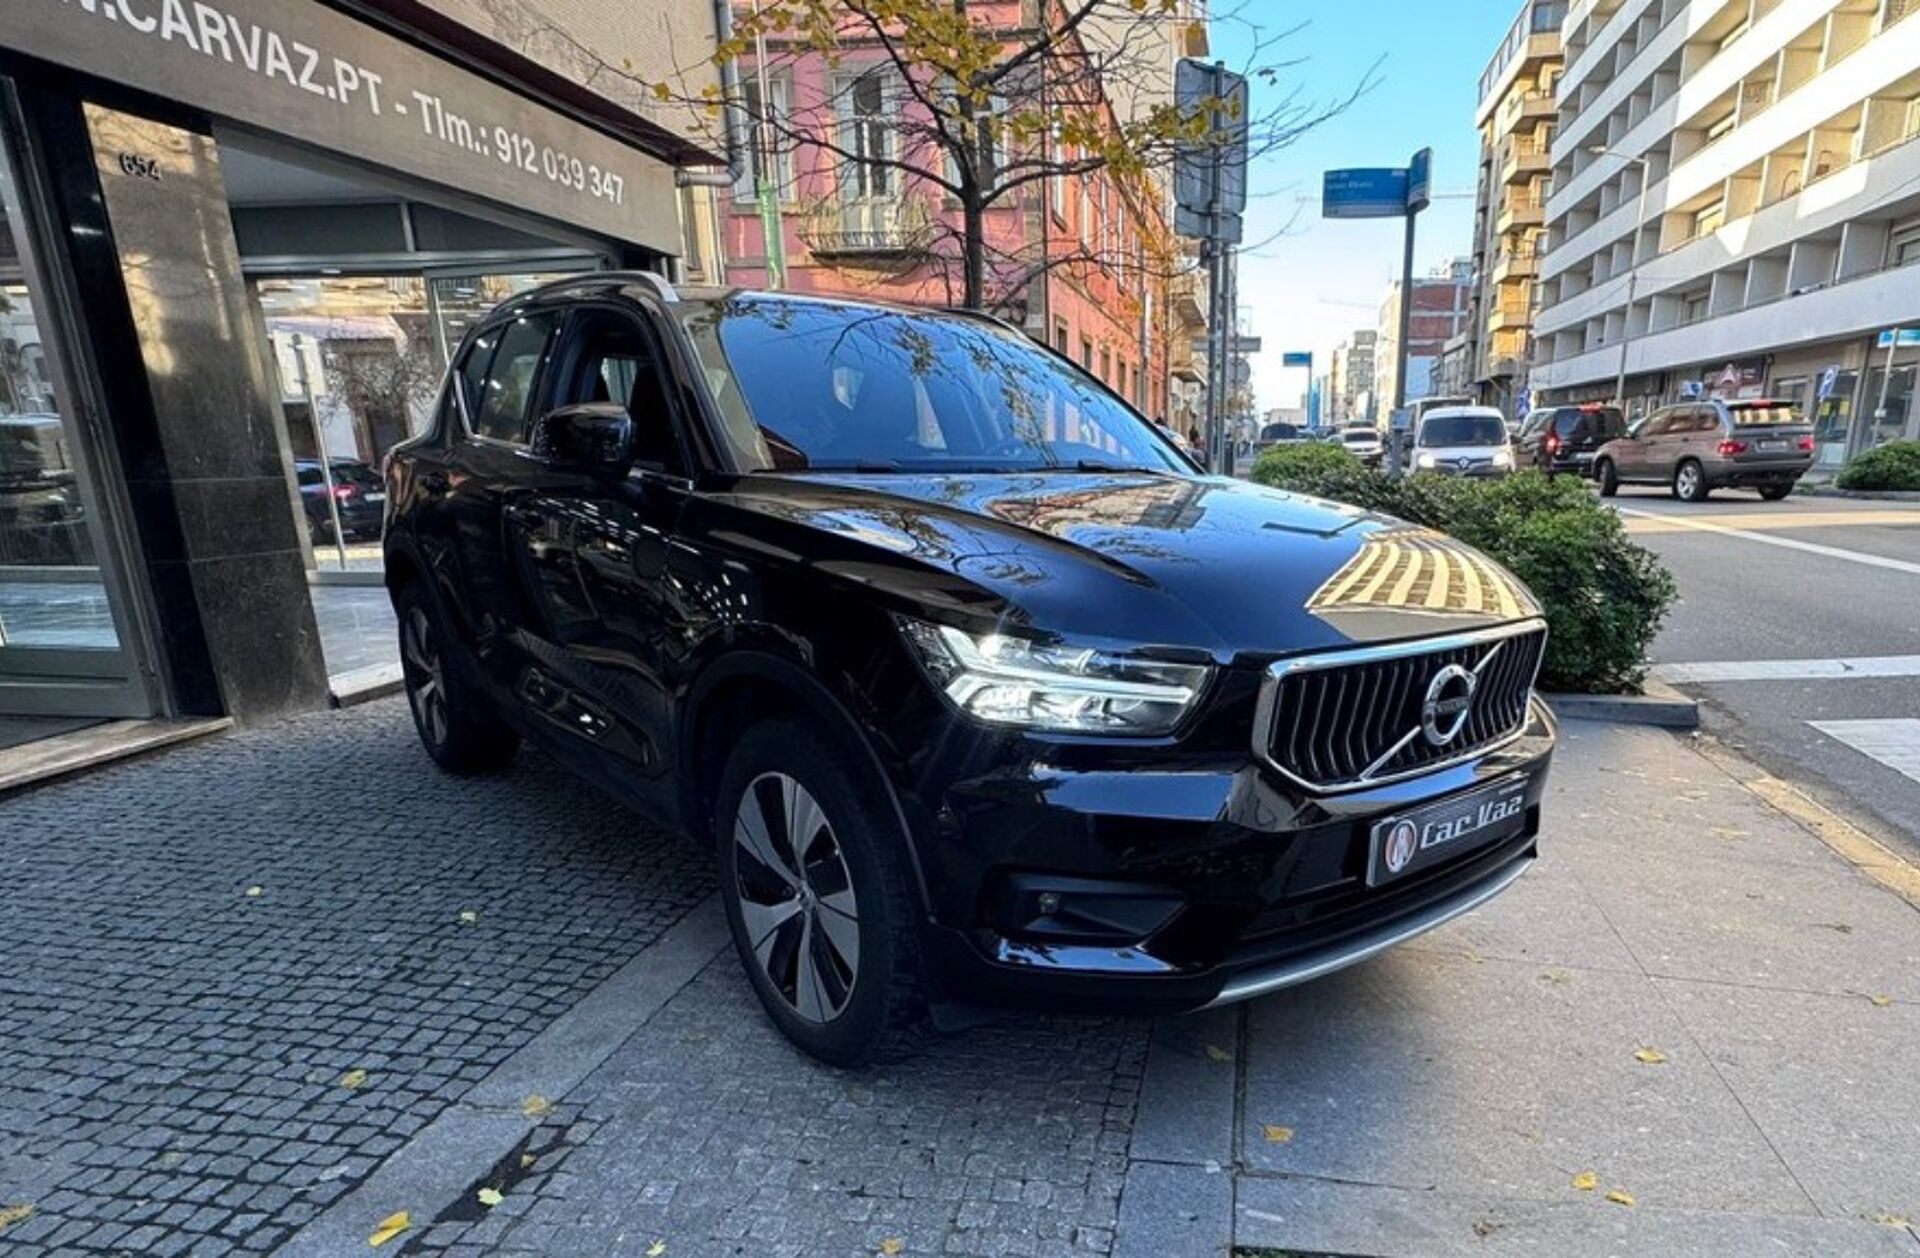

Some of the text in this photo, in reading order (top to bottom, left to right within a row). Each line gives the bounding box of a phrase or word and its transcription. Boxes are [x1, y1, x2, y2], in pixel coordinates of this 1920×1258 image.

[59, 0, 383, 116] .CARVAZ.PT
[411, 89, 490, 156] Tlm.:
[494, 126, 539, 174] 912
[542, 146, 586, 191] 039
[588, 164, 624, 205] 347
[118, 152, 161, 181] 654
[1420, 815, 1472, 849] Car
